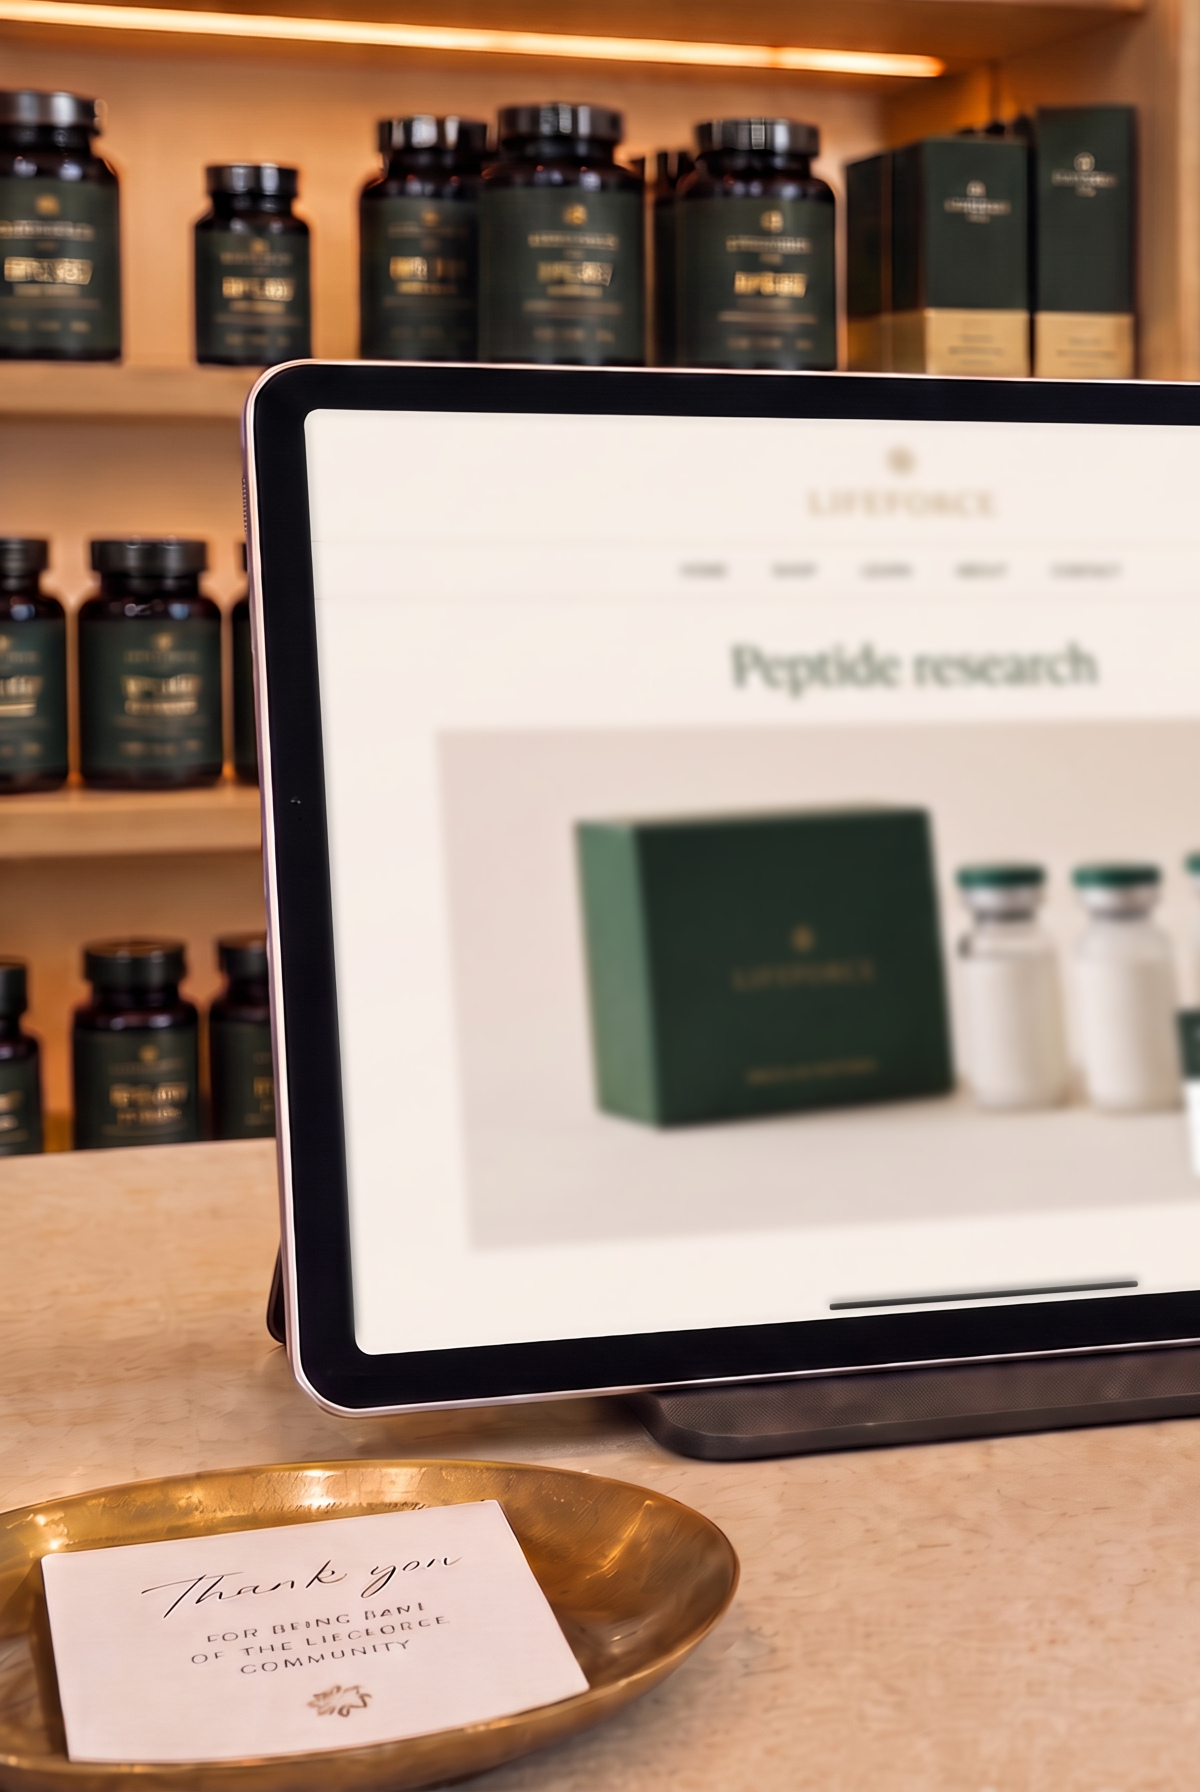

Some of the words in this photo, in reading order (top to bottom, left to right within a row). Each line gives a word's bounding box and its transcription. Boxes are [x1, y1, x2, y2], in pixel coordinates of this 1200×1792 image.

[730, 642, 902, 696] Peptide
[913, 642, 1098, 688] research
[141, 1560, 347, 1619] Thank
[240, 1639, 410, 1675] COMMUNITY
[242, 1641, 293, 1657] THE
